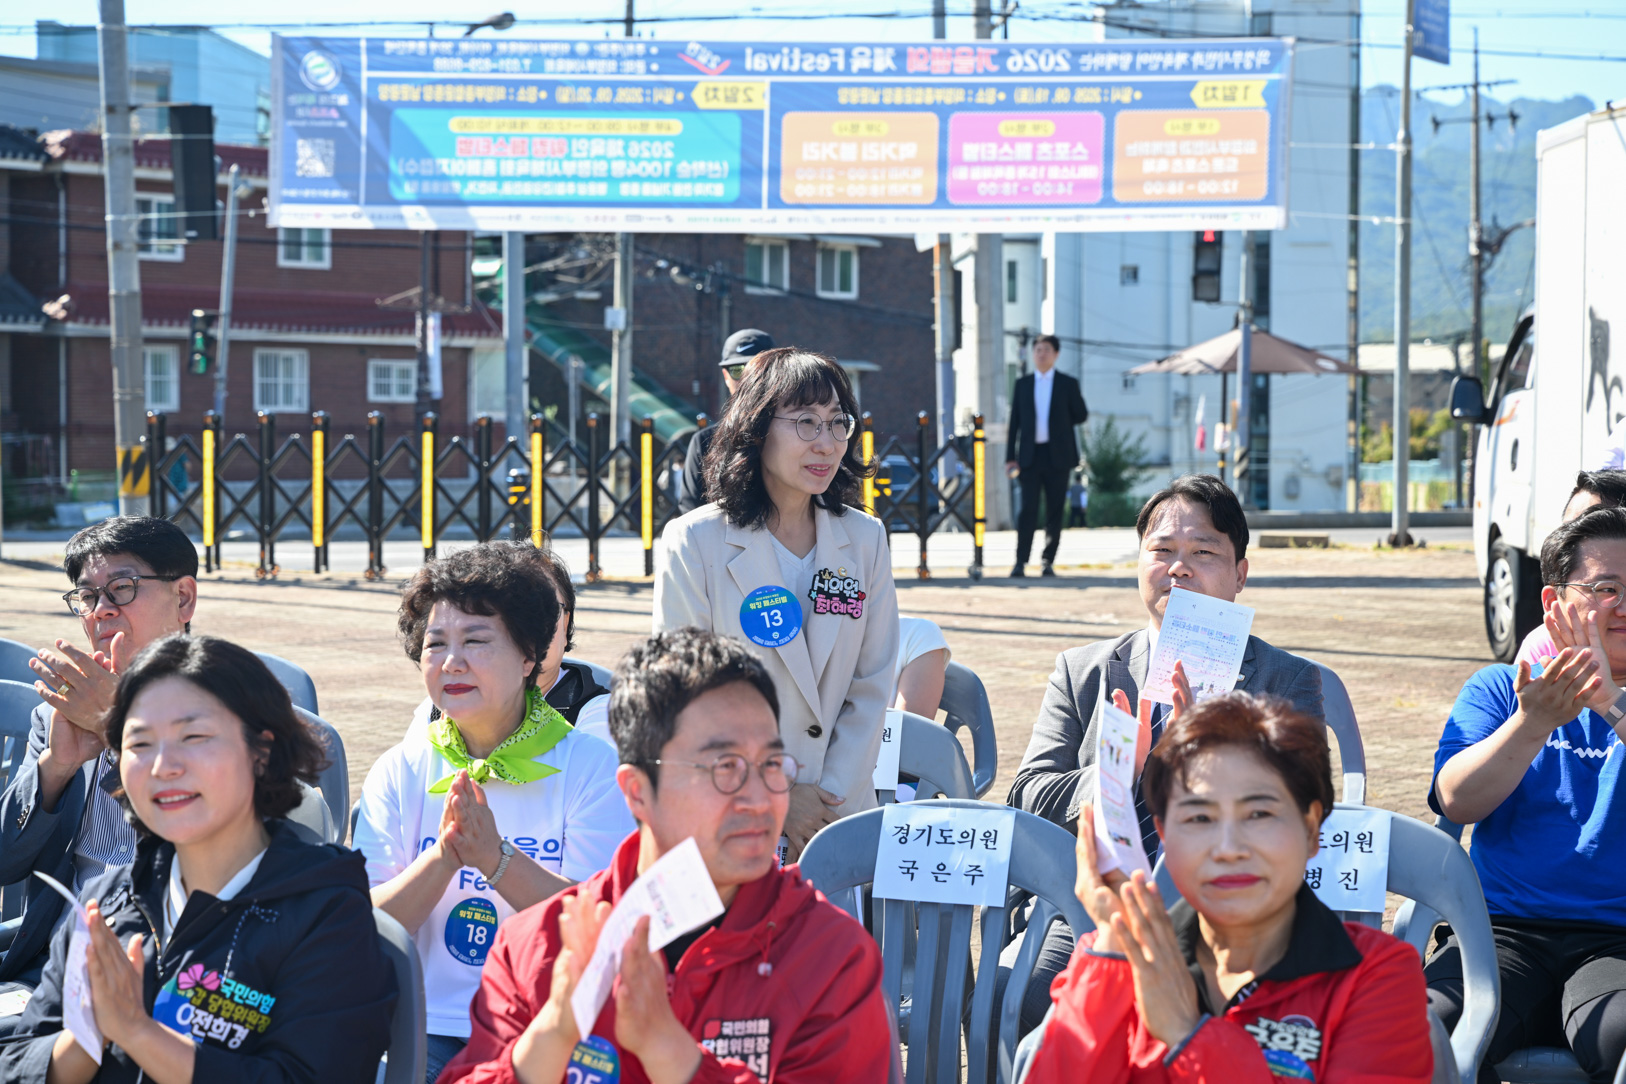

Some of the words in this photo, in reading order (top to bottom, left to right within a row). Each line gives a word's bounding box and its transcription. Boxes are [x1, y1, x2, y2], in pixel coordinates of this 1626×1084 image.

[814, 576, 859, 598] 시의원
[749, 600, 762, 610] 워킹
[763, 596, 788, 607] 페스티벌
[816, 594, 863, 618] 최혜령
[760, 609, 783, 628] 13
[892, 824, 998, 851] 경기도의원
[898, 860, 919, 882] 국
[931, 862, 951, 883] 은
[964, 864, 984, 886] 주
[1338, 868, 1358, 891] 진
[459, 910, 473, 919] 워킹
[474, 912, 496, 924] 페스티벌
[466, 924, 487, 945] 18
[220, 978, 276, 1015] 국민의힘
[208, 994, 271, 1032] 당협위원장
[192, 1008, 250, 1049] 전희경
[722, 1018, 770, 1036] 국민의힘
